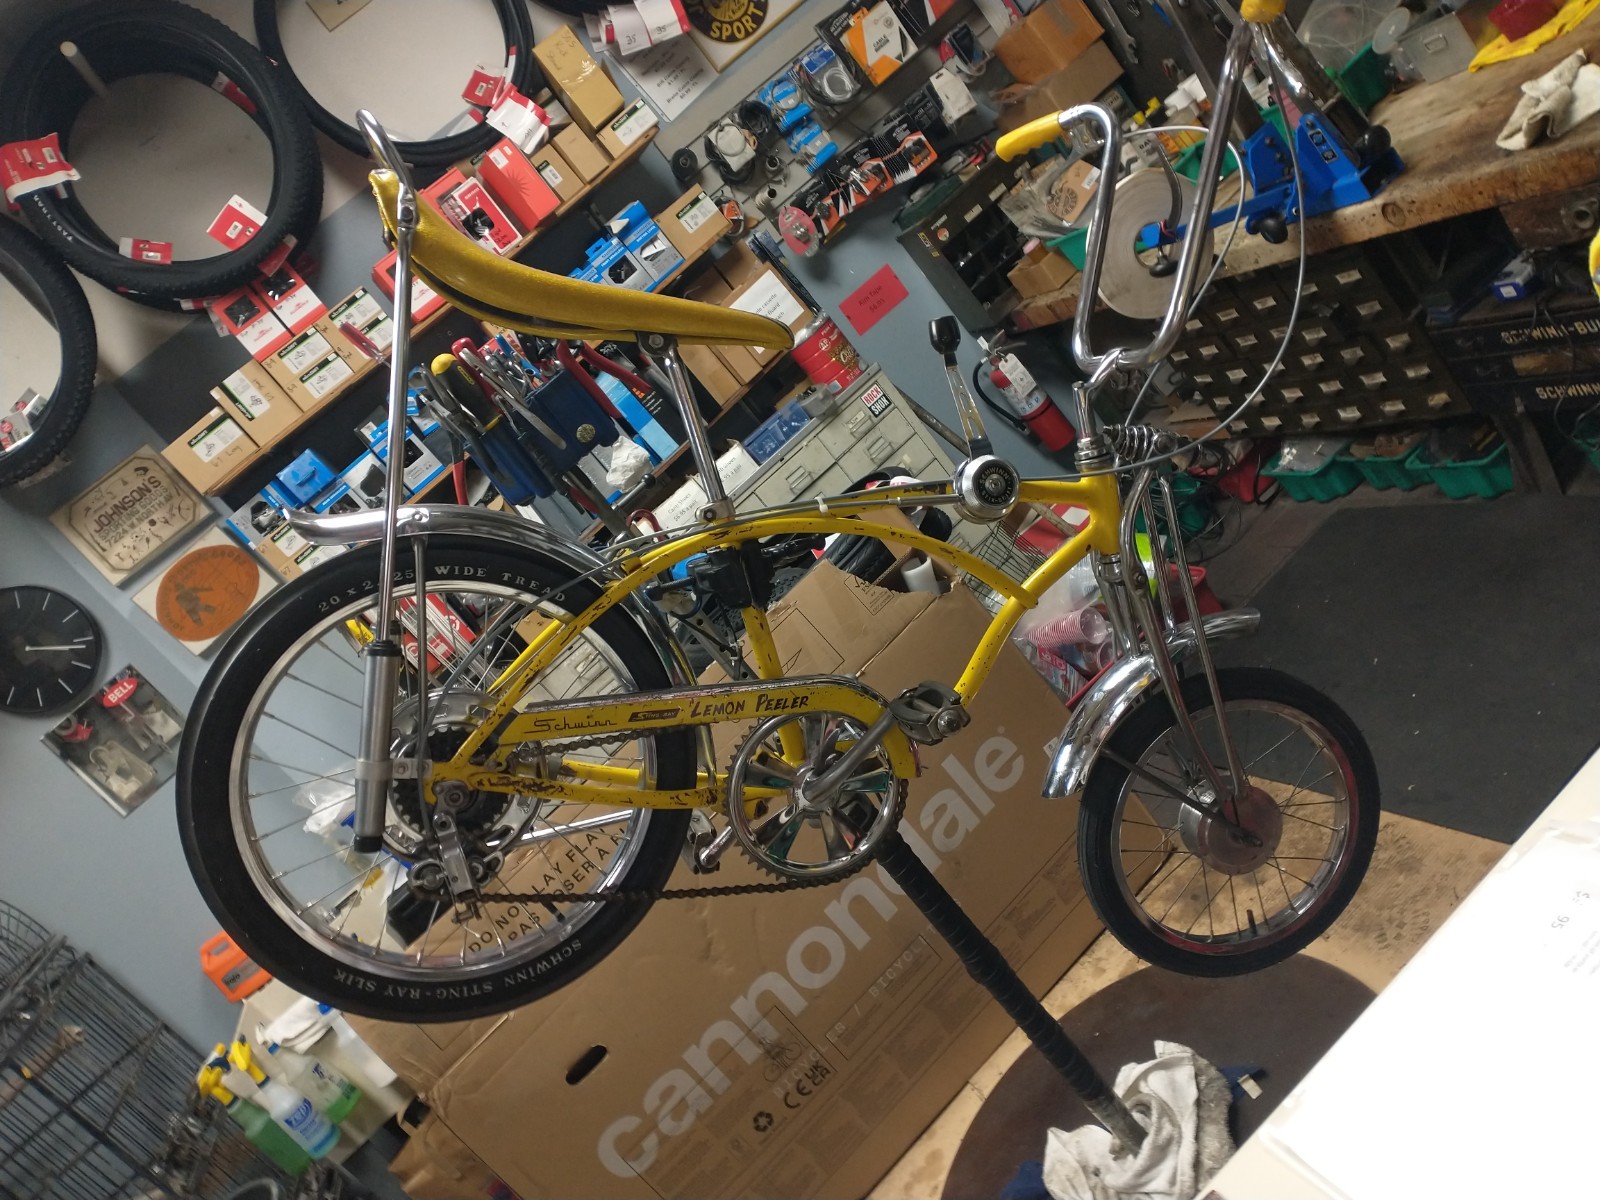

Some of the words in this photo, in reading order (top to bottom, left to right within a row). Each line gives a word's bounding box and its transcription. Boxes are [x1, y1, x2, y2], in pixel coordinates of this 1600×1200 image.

[711, 5, 764, 40] SPORT
[863, 386, 881, 404] ROCK
[870, 395, 889, 415] SHOX
[979, 466, 1009, 484] SCHWINN
[94, 475, 162, 533] JOHNSON'S
[100, 505, 140, 541] SPORTING
[138, 484, 169, 510] GOODS
[105, 527, 129, 548] 7224
[136, 500, 164, 526] NORTH
[318, 594, 340, 613] 20
[434, 565, 487, 578] WIDE
[501, 572, 566, 602] TREAD
[108, 682, 134, 703] BELL
[524, 714, 618, 734] Schwinn
[468, 931, 493, 953] DO
[531, 862, 563, 895] LAY
[567, 828, 606, 863] FLA
[332, 967, 378, 994] SLIK
[503, 939, 582, 989] SCHWINN
